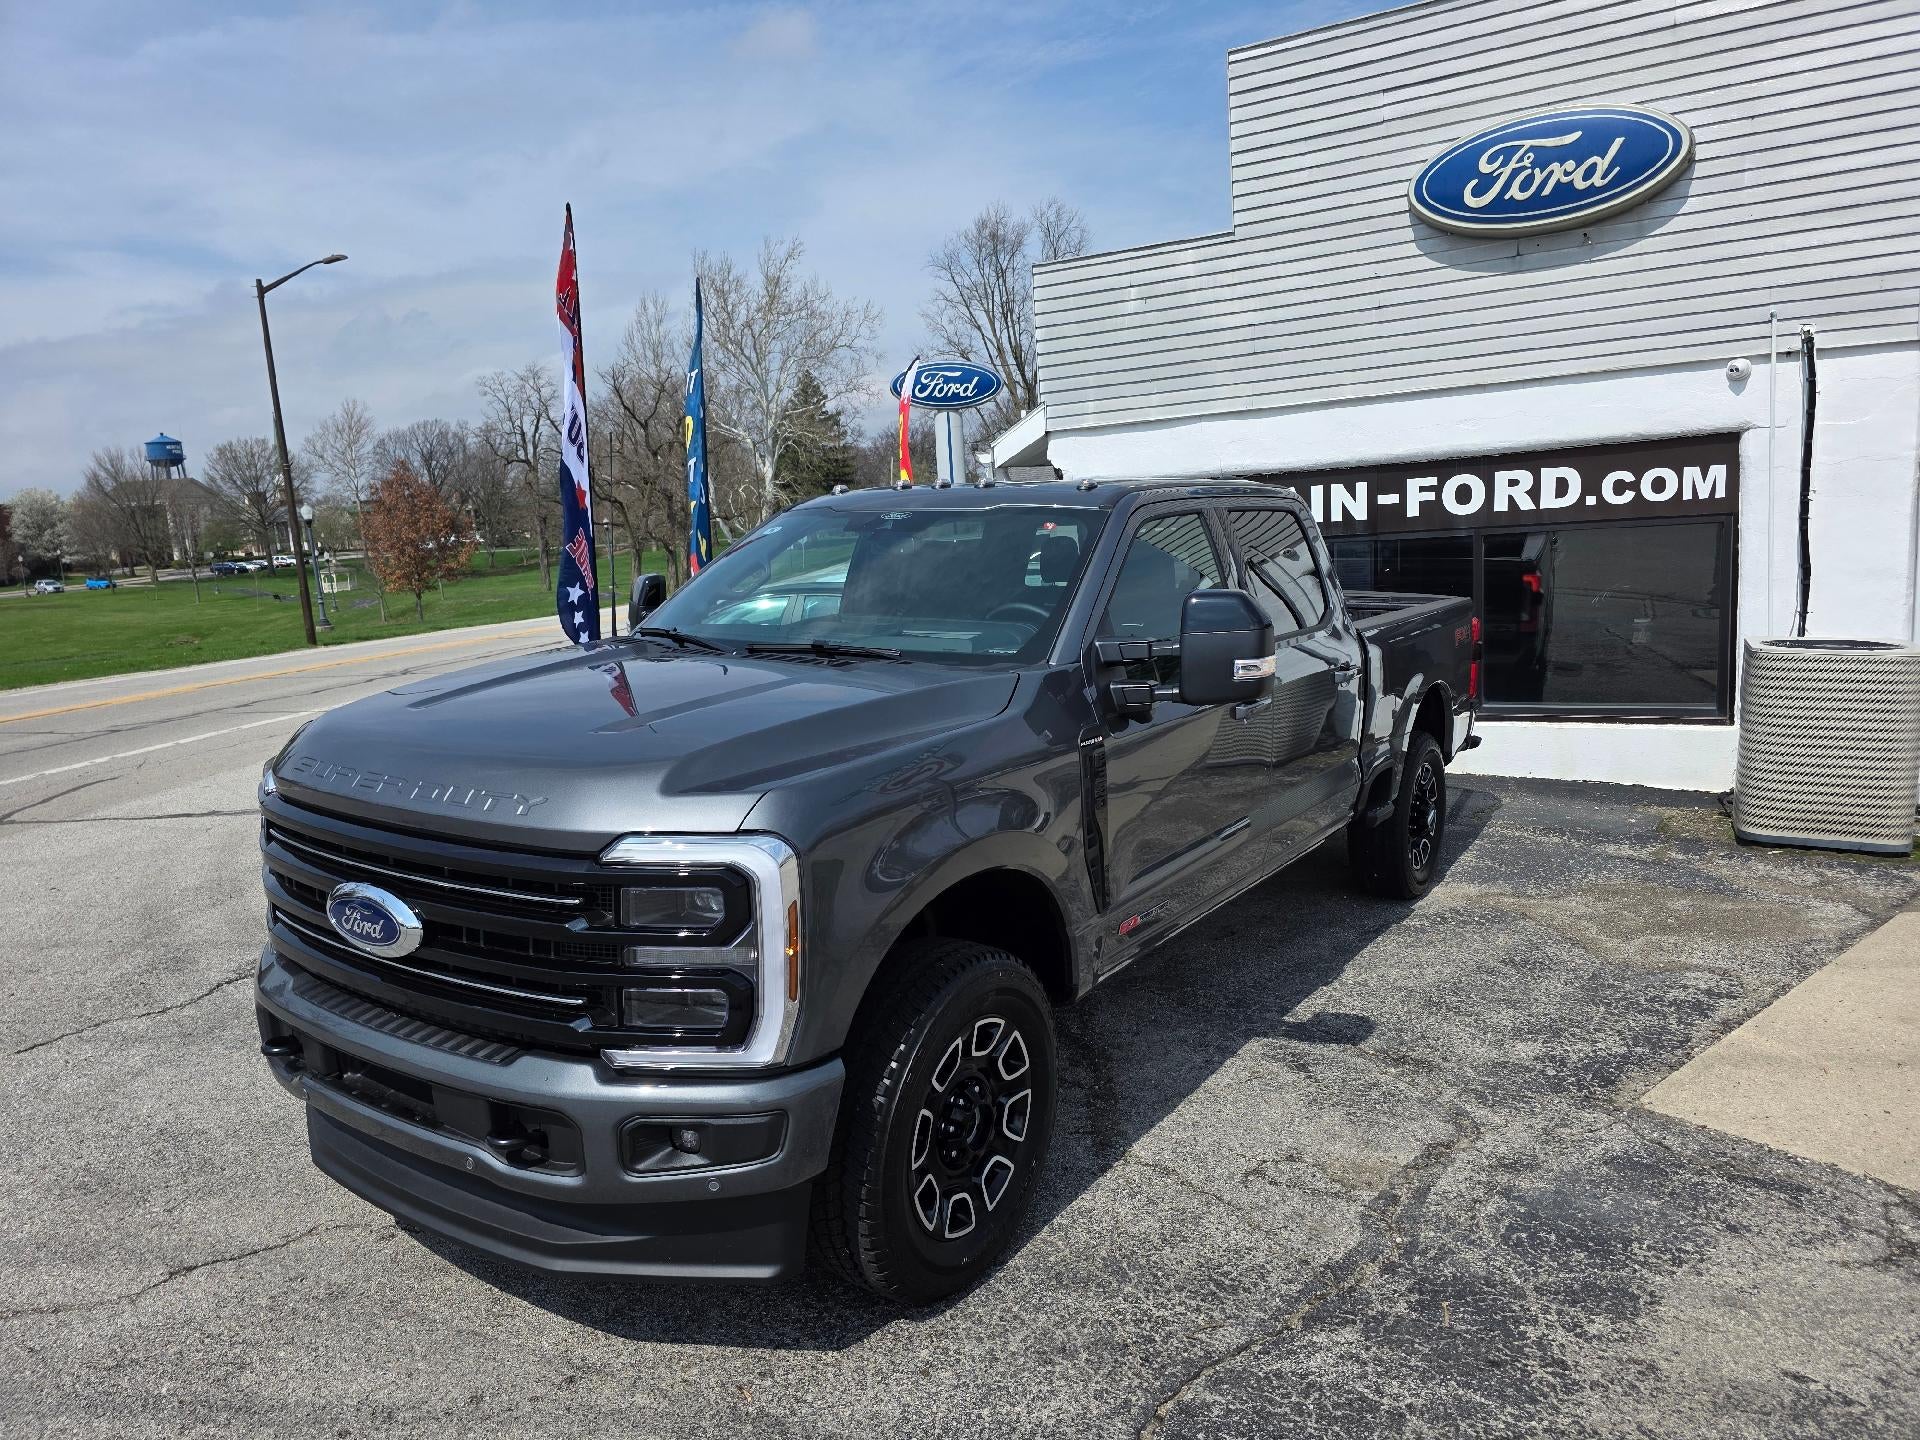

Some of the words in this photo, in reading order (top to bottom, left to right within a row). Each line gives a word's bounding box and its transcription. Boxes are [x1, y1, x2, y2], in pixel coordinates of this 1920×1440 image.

[1463, 130, 1626, 209] Ford
[914, 371, 980, 398] Ford
[1289, 464, 1728, 523] IN-FORD.COM
[293, 756, 409, 793] SUPER
[410, 779, 550, 816] DUTY
[341, 903, 385, 939] Ford
